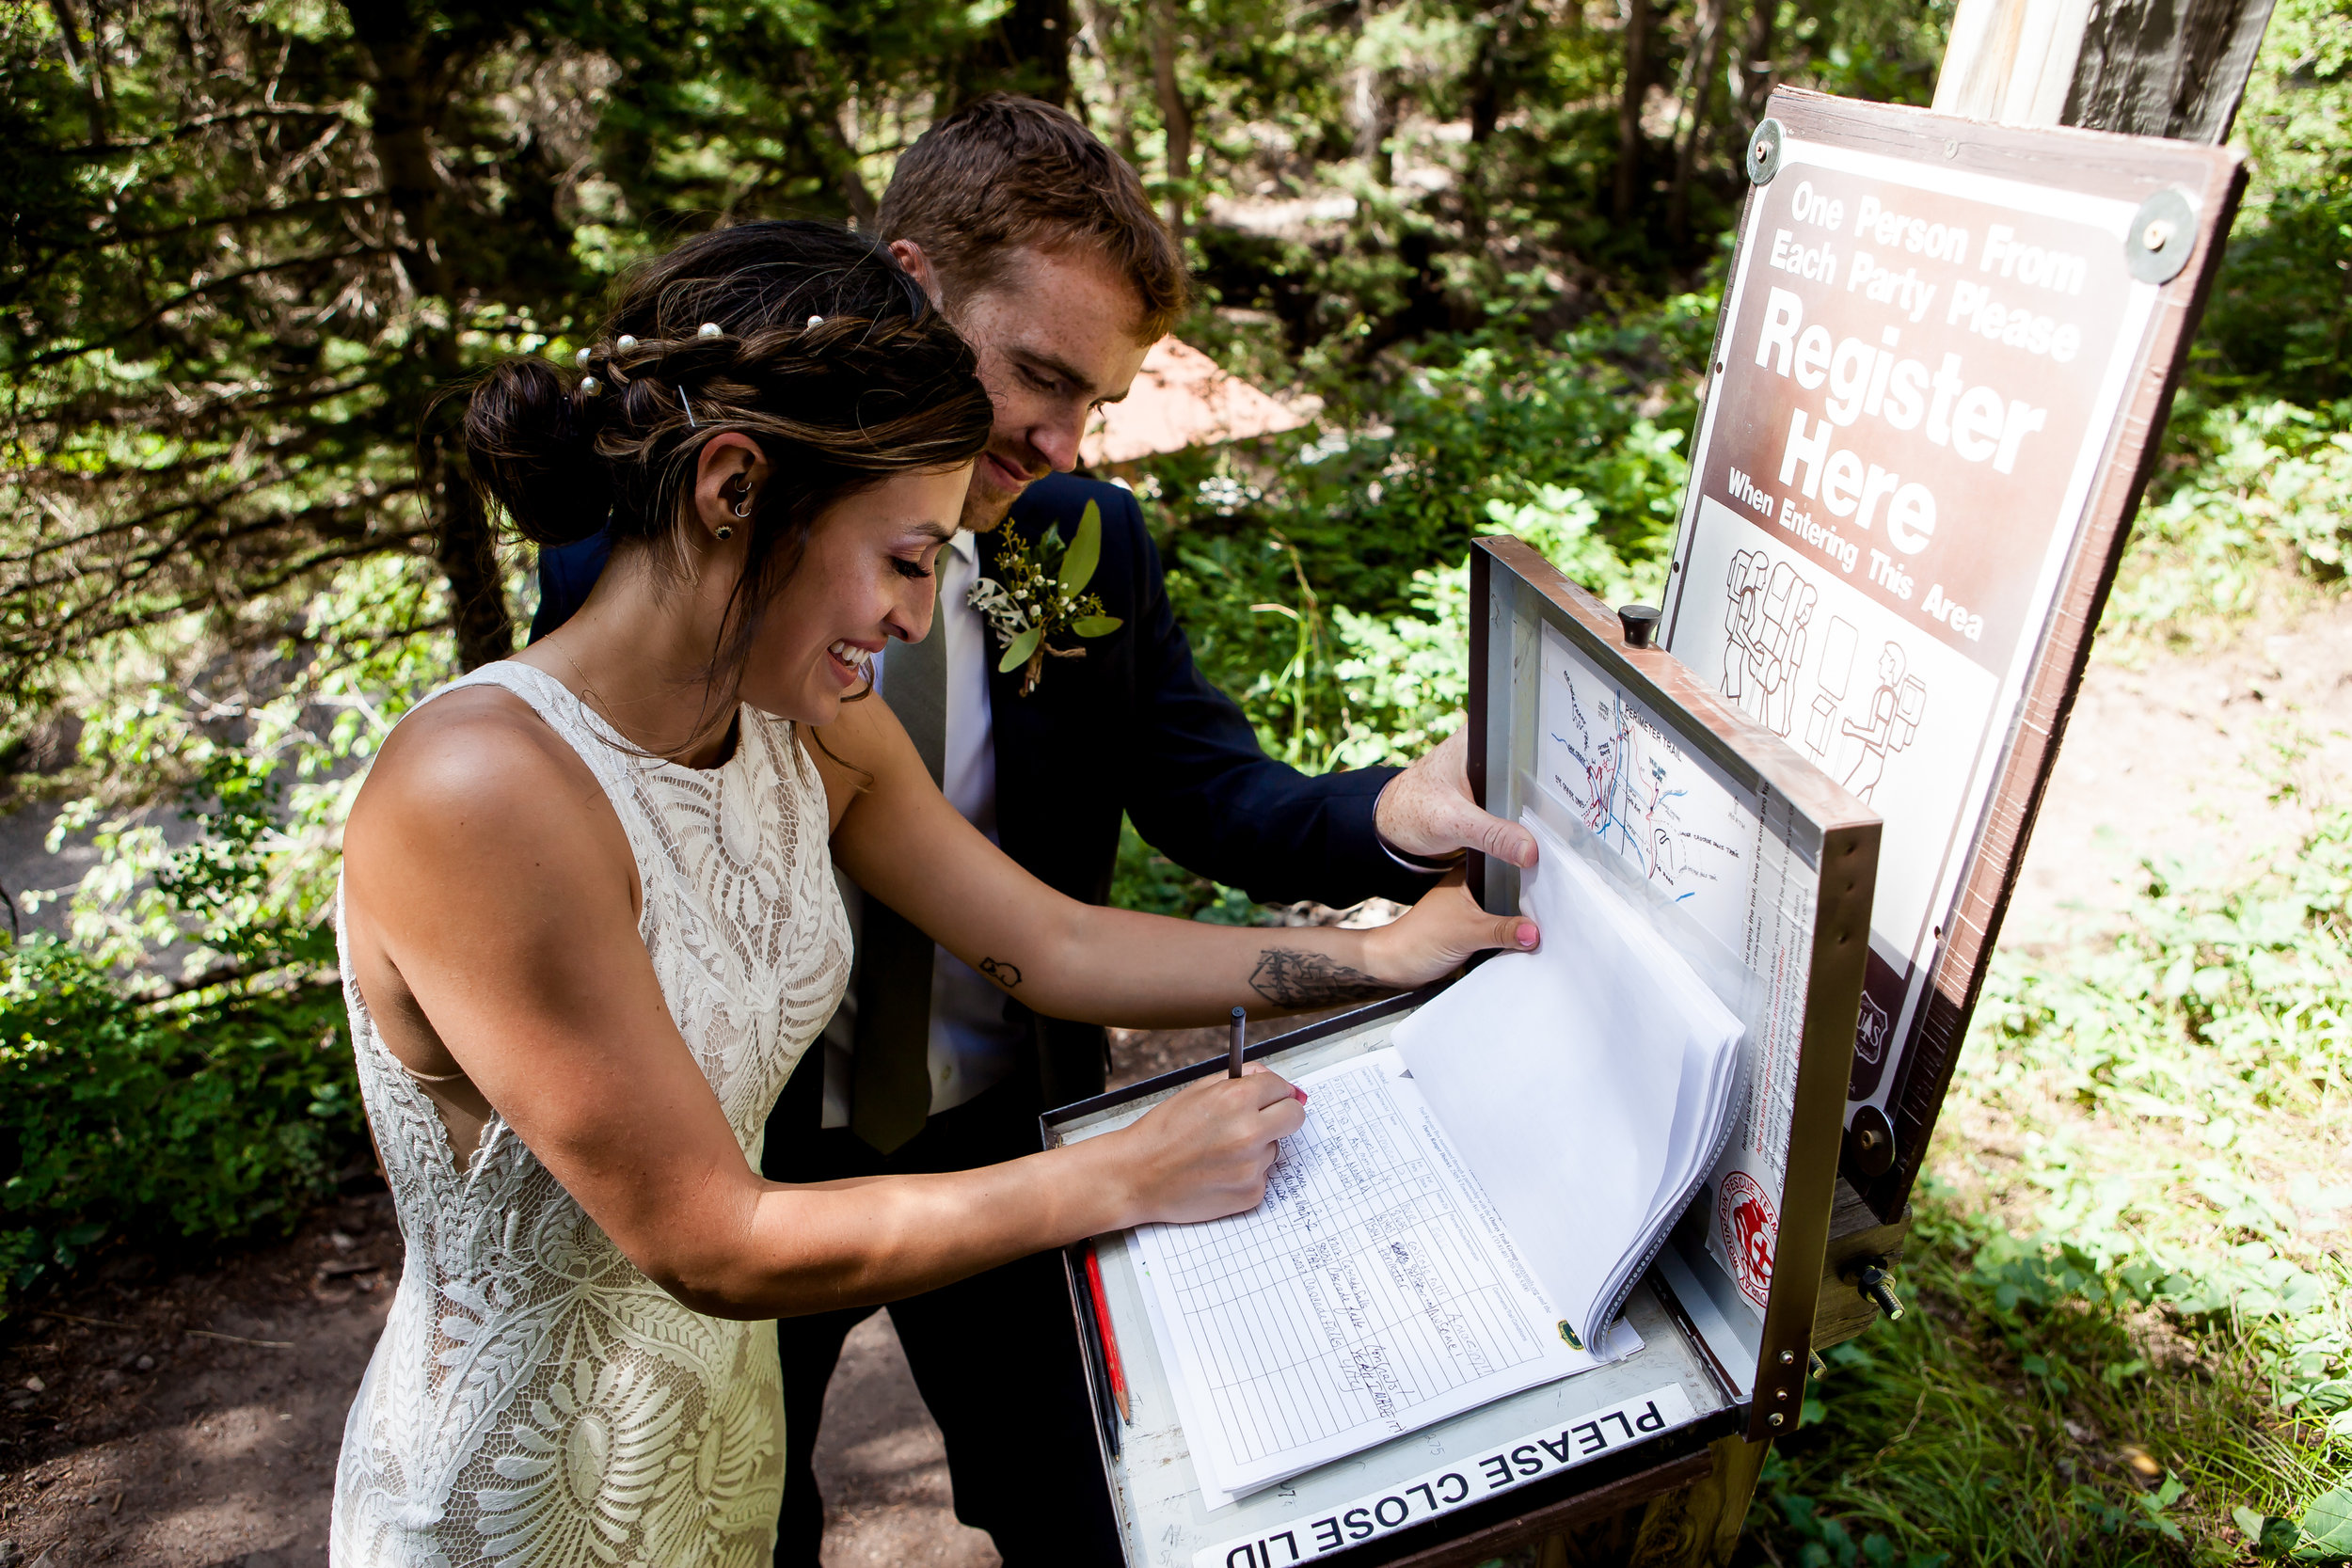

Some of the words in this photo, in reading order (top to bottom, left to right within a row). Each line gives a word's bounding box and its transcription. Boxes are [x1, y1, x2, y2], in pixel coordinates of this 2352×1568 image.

[1791, 181, 1844, 230] One
[1854, 195, 1970, 264] Person
[1979, 224, 2088, 295] From
[1769, 229, 1837, 285] Each
[1847, 250, 1936, 323] Party
[1947, 279, 2081, 363] Please
[1755, 286, 2048, 475] Register
[1778, 407, 1937, 555] Here
[1727, 466, 1774, 517] When
[1778, 497, 1859, 574] Entering
[1867, 547, 1915, 601] This
[1920, 583, 1984, 642] Area
[1625, 704, 1661, 743] PERIMETER
[1662, 737, 1682, 762] TRAIL
[1779, 887, 1784, 897] be
[1787, 930, 1796, 968] expected
[1756, 1130, 1764, 1156] Agree
[1763, 1060, 1772, 1096] together
[1772, 985, 1780, 1019] around
[1776, 944, 1787, 984] together
[1756, 1064, 1764, 1091] putting
[1779, 1055, 1788, 1090] prepared
[1755, 1091, 1760, 1101] by
[1422, 1115, 1438, 1131] Register
[1751, 1102, 1759, 1128] battery
[1438, 1137, 1455, 1159] maintained
[1740, 1123, 1749, 1150] Before
[1450, 1158, 1465, 1174] through
[1420, 1124, 1434, 1137] Ouray
[1428, 1137, 1443, 1152] Ranger
[1490, 1235, 1502, 1244] CO
[1459, 1177, 1481, 1200] partnership
[1724, 1176, 1756, 1196] RESCUE
[1476, 1198, 1488, 1210] with
[1483, 1209, 1492, 1217] the
[1758, 1192, 1778, 1236] TEAM
[1486, 1216, 1502, 1232] Ouray
[1497, 1232, 1510, 1245] Trail
[1721, 1194, 1739, 1269] MOUNTAIN
[1503, 1243, 1521, 1261] Group
[1512, 1260, 1542, 1295] ouraytrails.org
[1536, 1294, 1548, 1306] and
[1542, 1305, 1553, 1314] the
[1350, 1347, 1378, 1381] YEAH
[1371, 1391, 1397, 1418] MADE
[1478, 1400, 1667, 1490] PLEASE
[1311, 1472, 1470, 1553] CLOSE
[1227, 1529, 1300, 1568] LID
